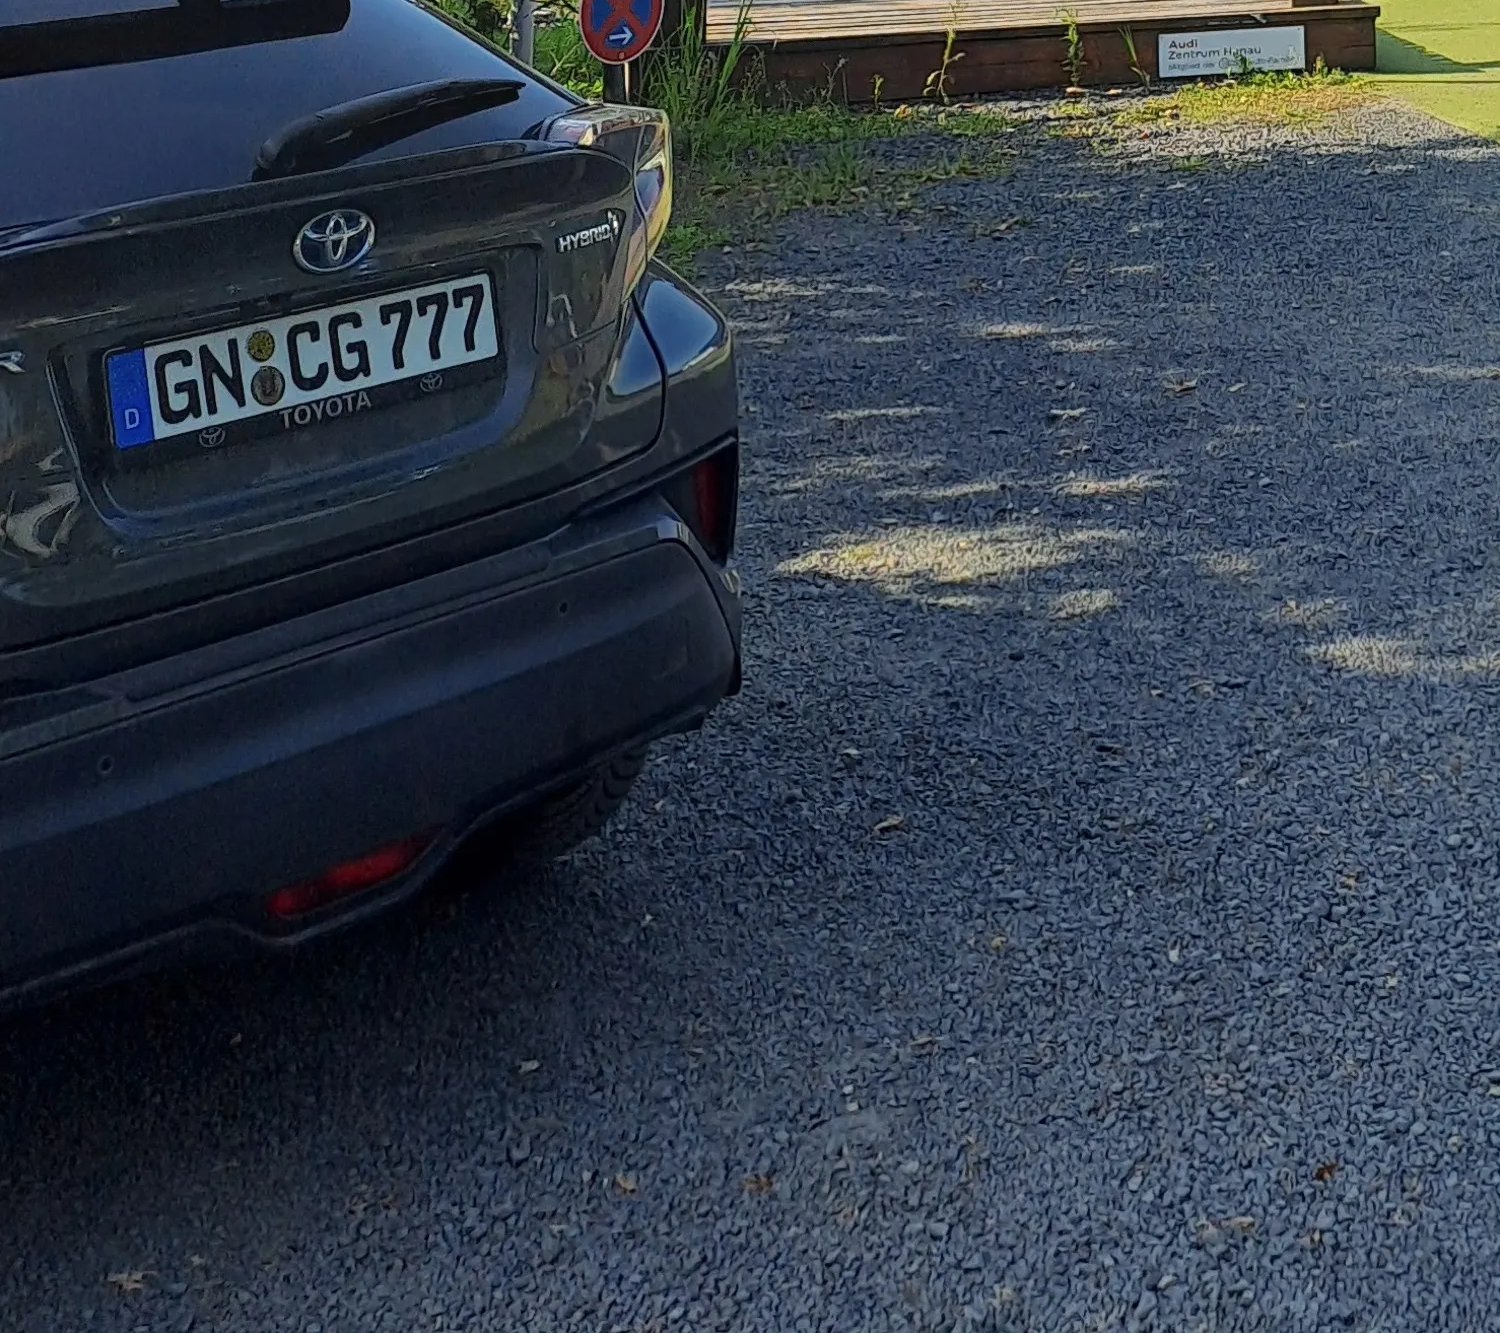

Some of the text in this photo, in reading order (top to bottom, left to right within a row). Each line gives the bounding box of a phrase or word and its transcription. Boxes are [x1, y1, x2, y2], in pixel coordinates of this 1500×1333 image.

[1168, 39, 1198, 49] Audi
[1168, 49, 1220, 60] Zentrum
[559, 223, 612, 253] HYBRID
[154, 283, 484, 425] GN CG 777
[124, 408, 141, 430] D
[279, 390, 372, 430] TOYOTA
